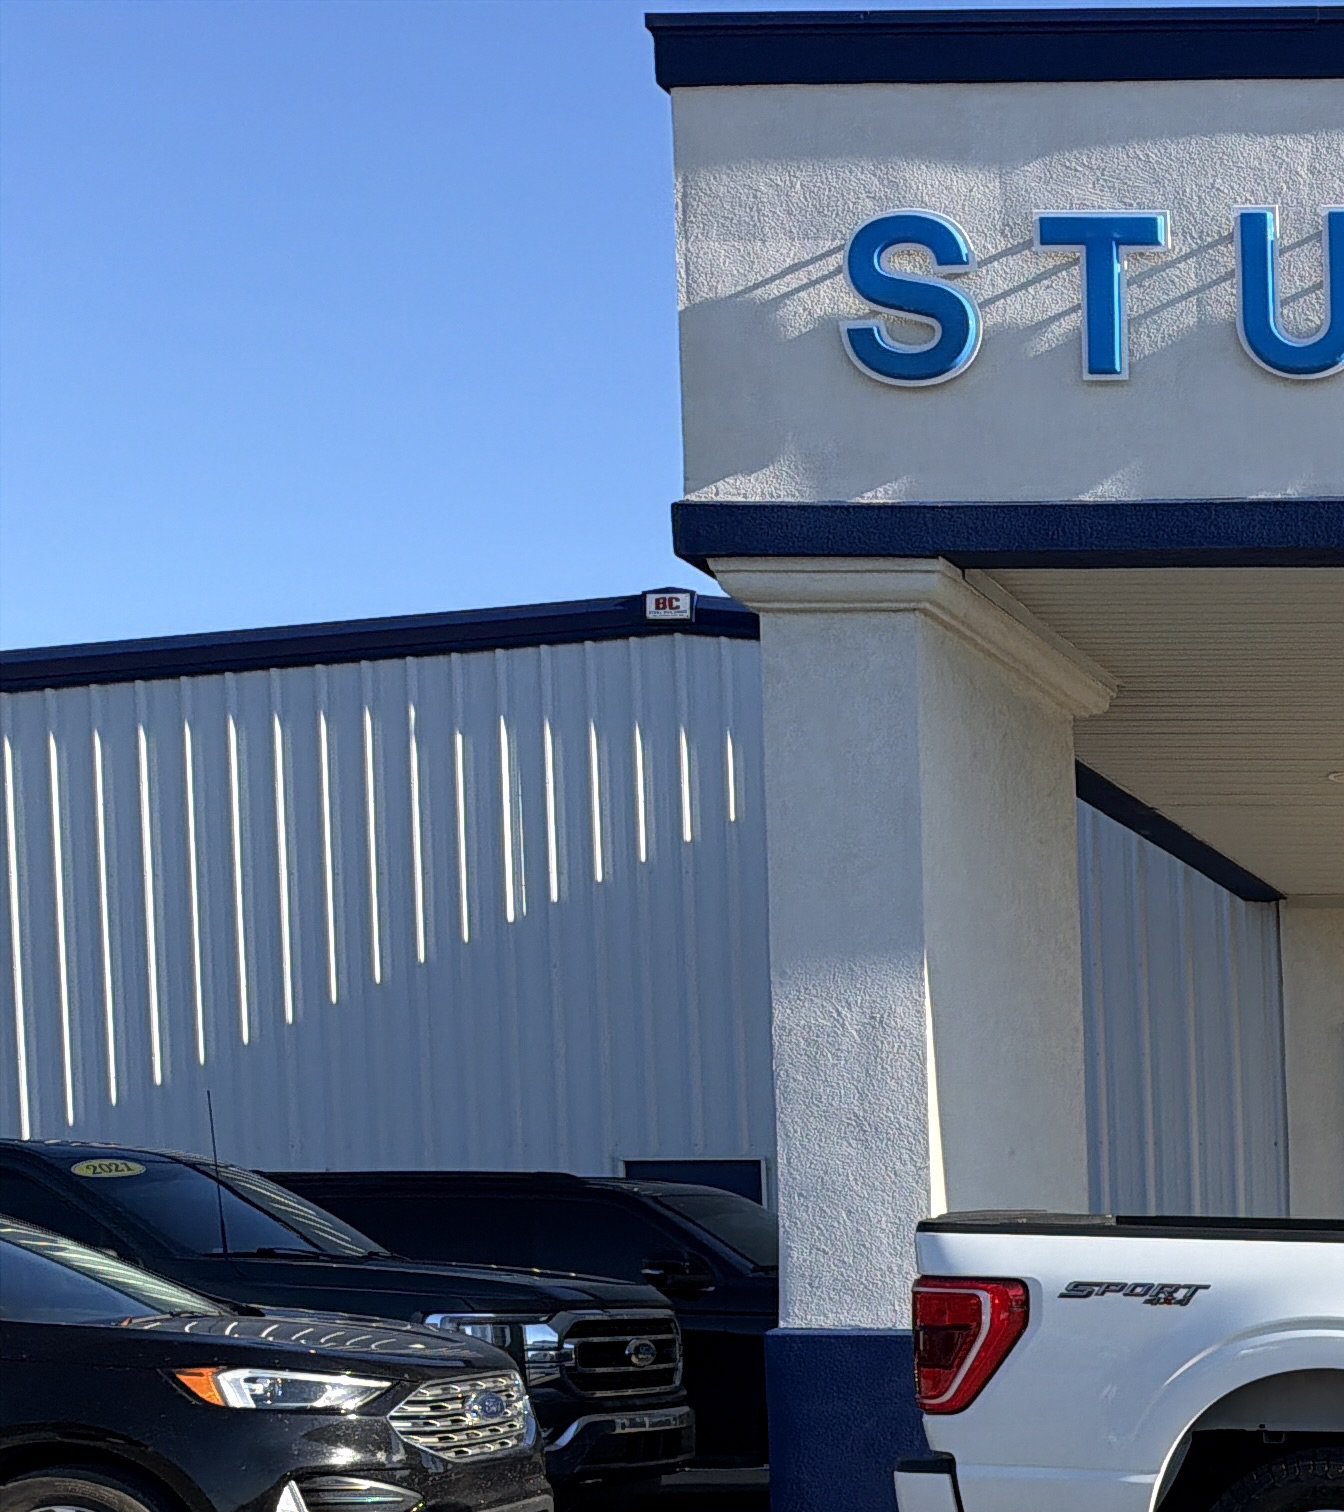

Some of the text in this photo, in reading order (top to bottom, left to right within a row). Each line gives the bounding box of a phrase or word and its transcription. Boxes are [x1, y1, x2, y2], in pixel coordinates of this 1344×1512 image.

[654, 596, 681, 611] BC
[85, 1162, 135, 1175] 2021
[1056, 1280, 1212, 1300] SPORT
